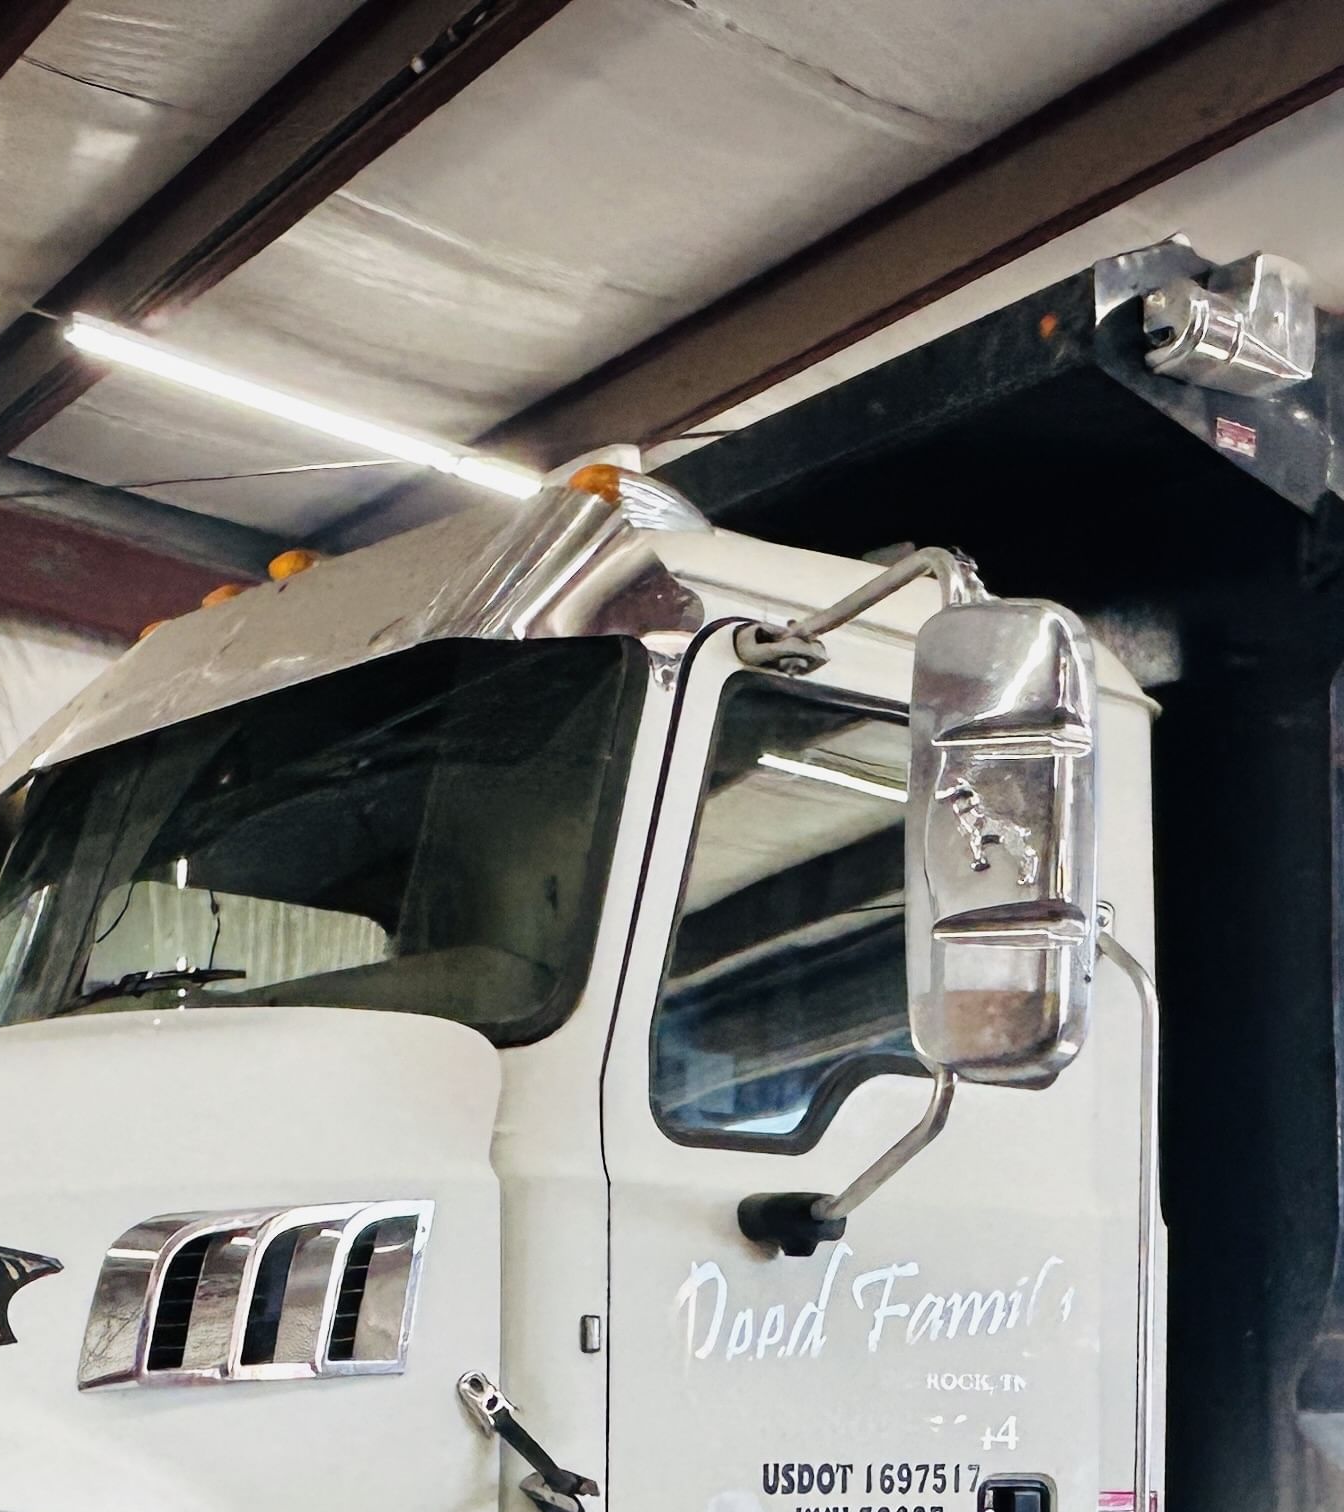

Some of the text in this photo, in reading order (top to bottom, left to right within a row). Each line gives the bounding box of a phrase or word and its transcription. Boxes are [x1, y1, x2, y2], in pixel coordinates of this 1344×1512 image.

[852, 1256, 1075, 1352] Famil
[762, 1462, 981, 1495] USDOT 1697517
